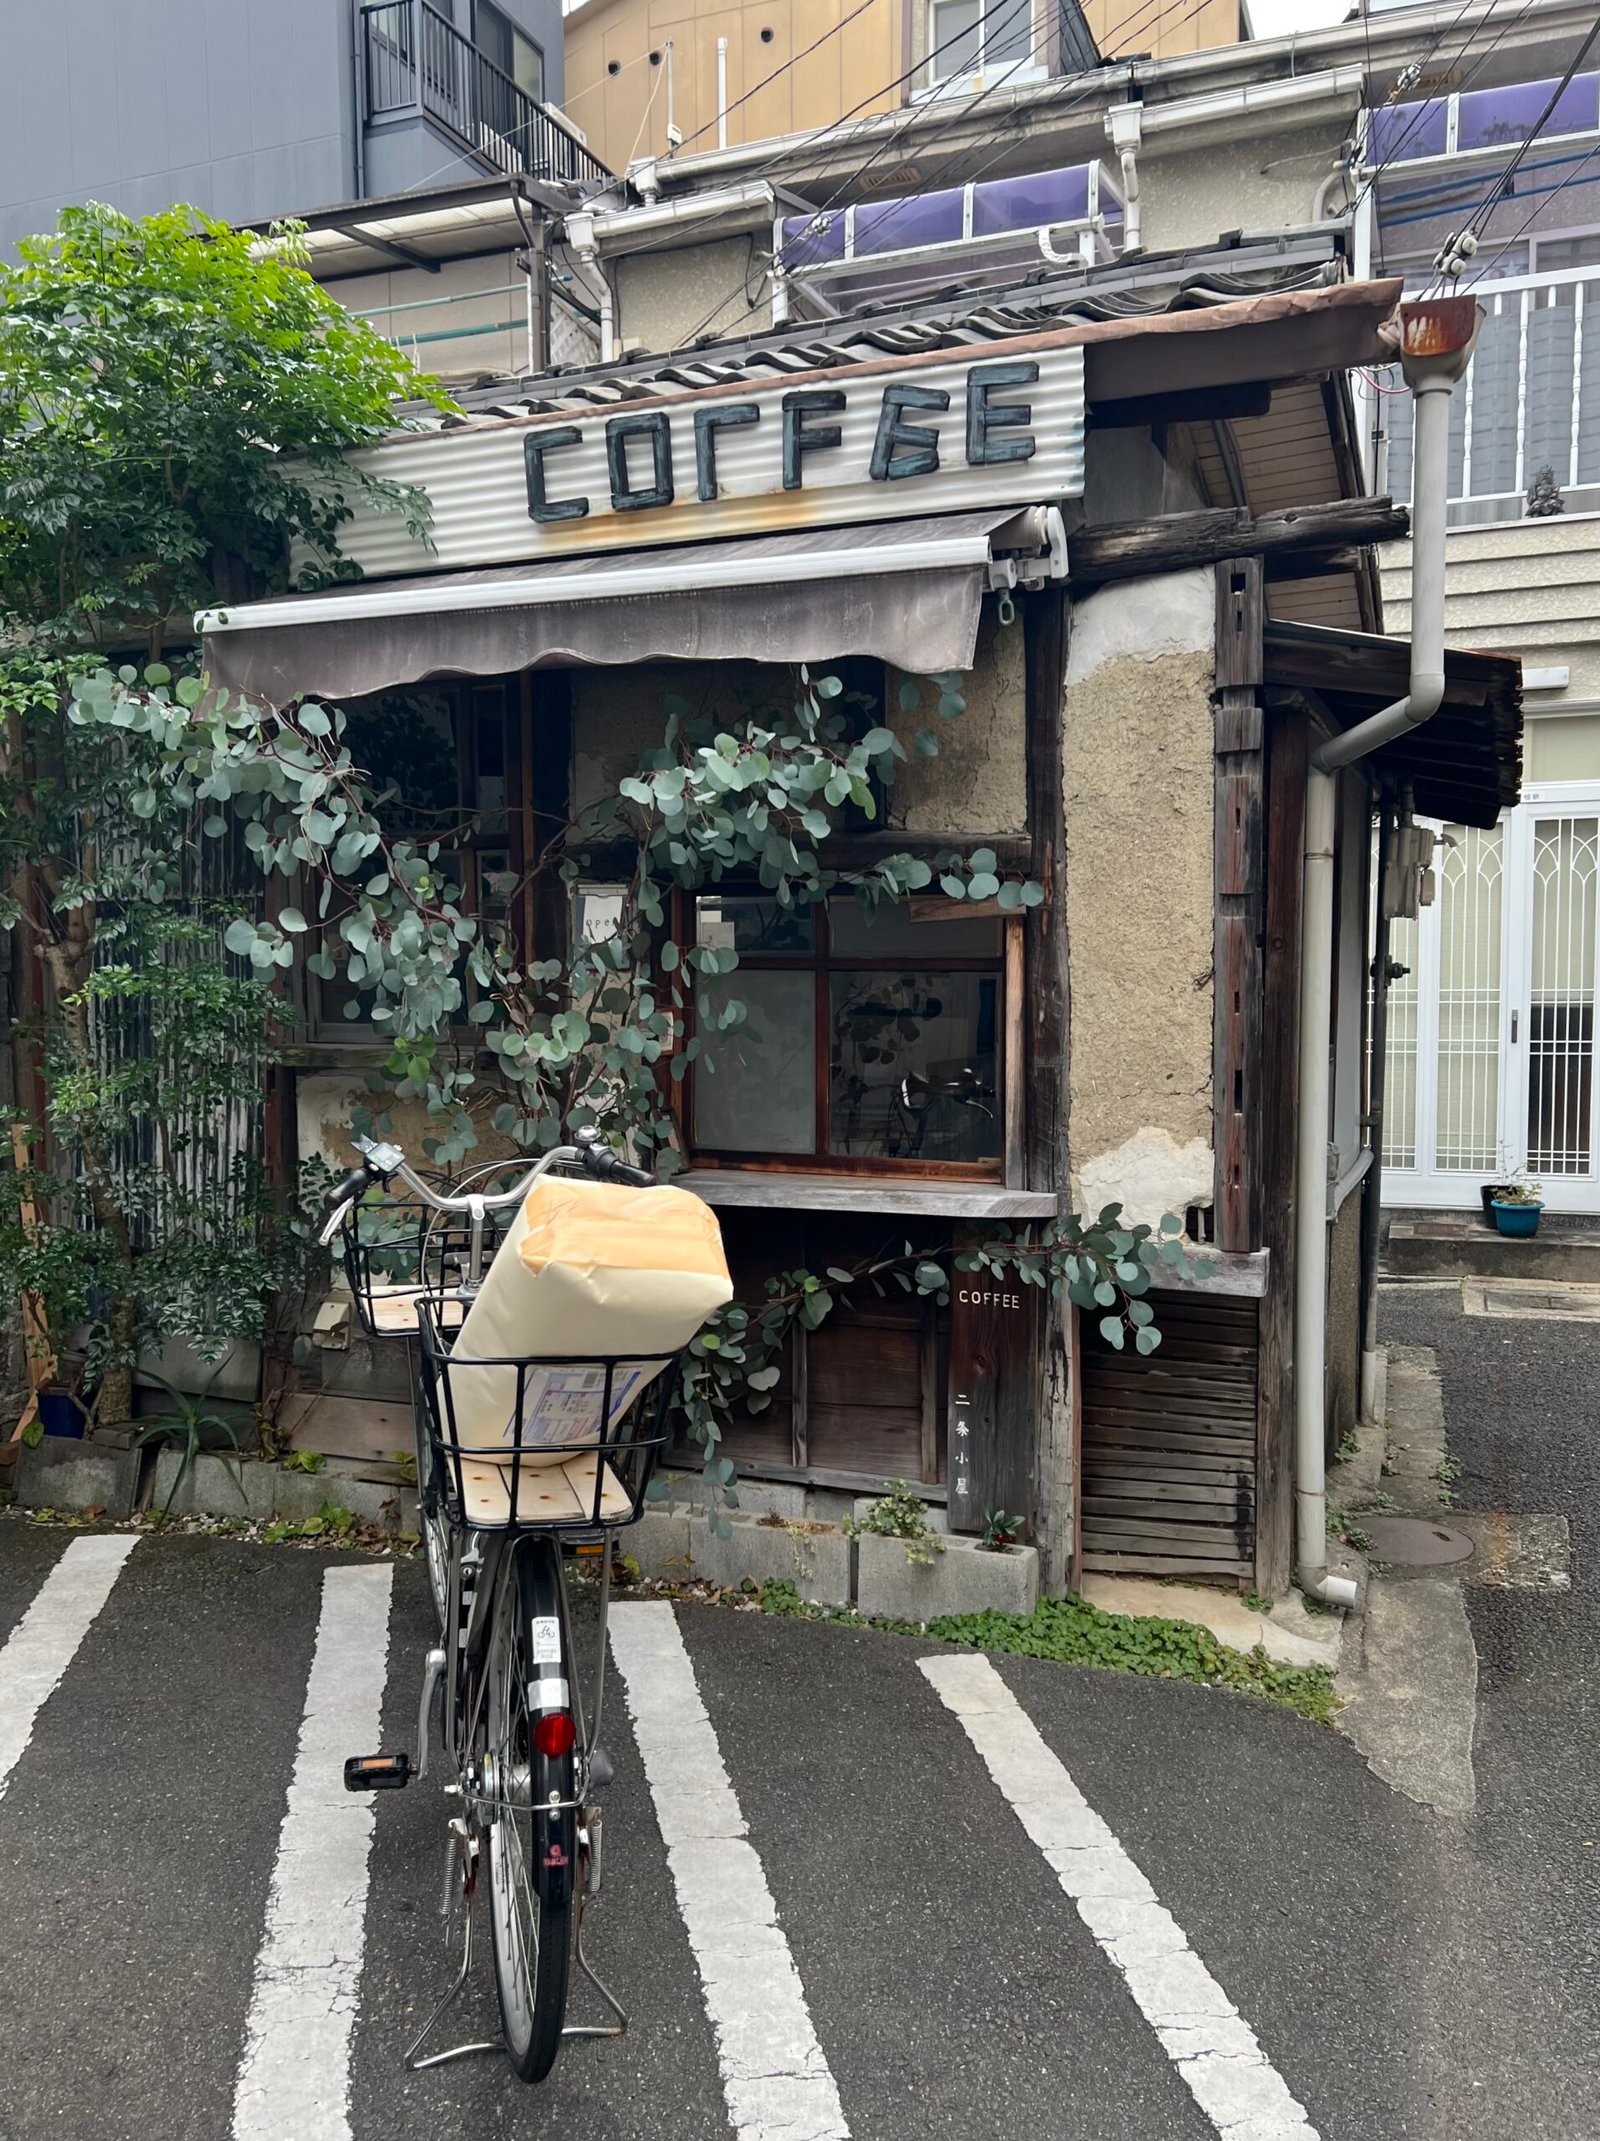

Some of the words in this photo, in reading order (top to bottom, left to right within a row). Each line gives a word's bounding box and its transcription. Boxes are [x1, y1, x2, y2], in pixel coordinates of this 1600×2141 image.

[585, 919, 617, 928] ope
[959, 1290, 1020, 1309] COFFEE
[955, 1394, 970, 1494] 二条小屋
